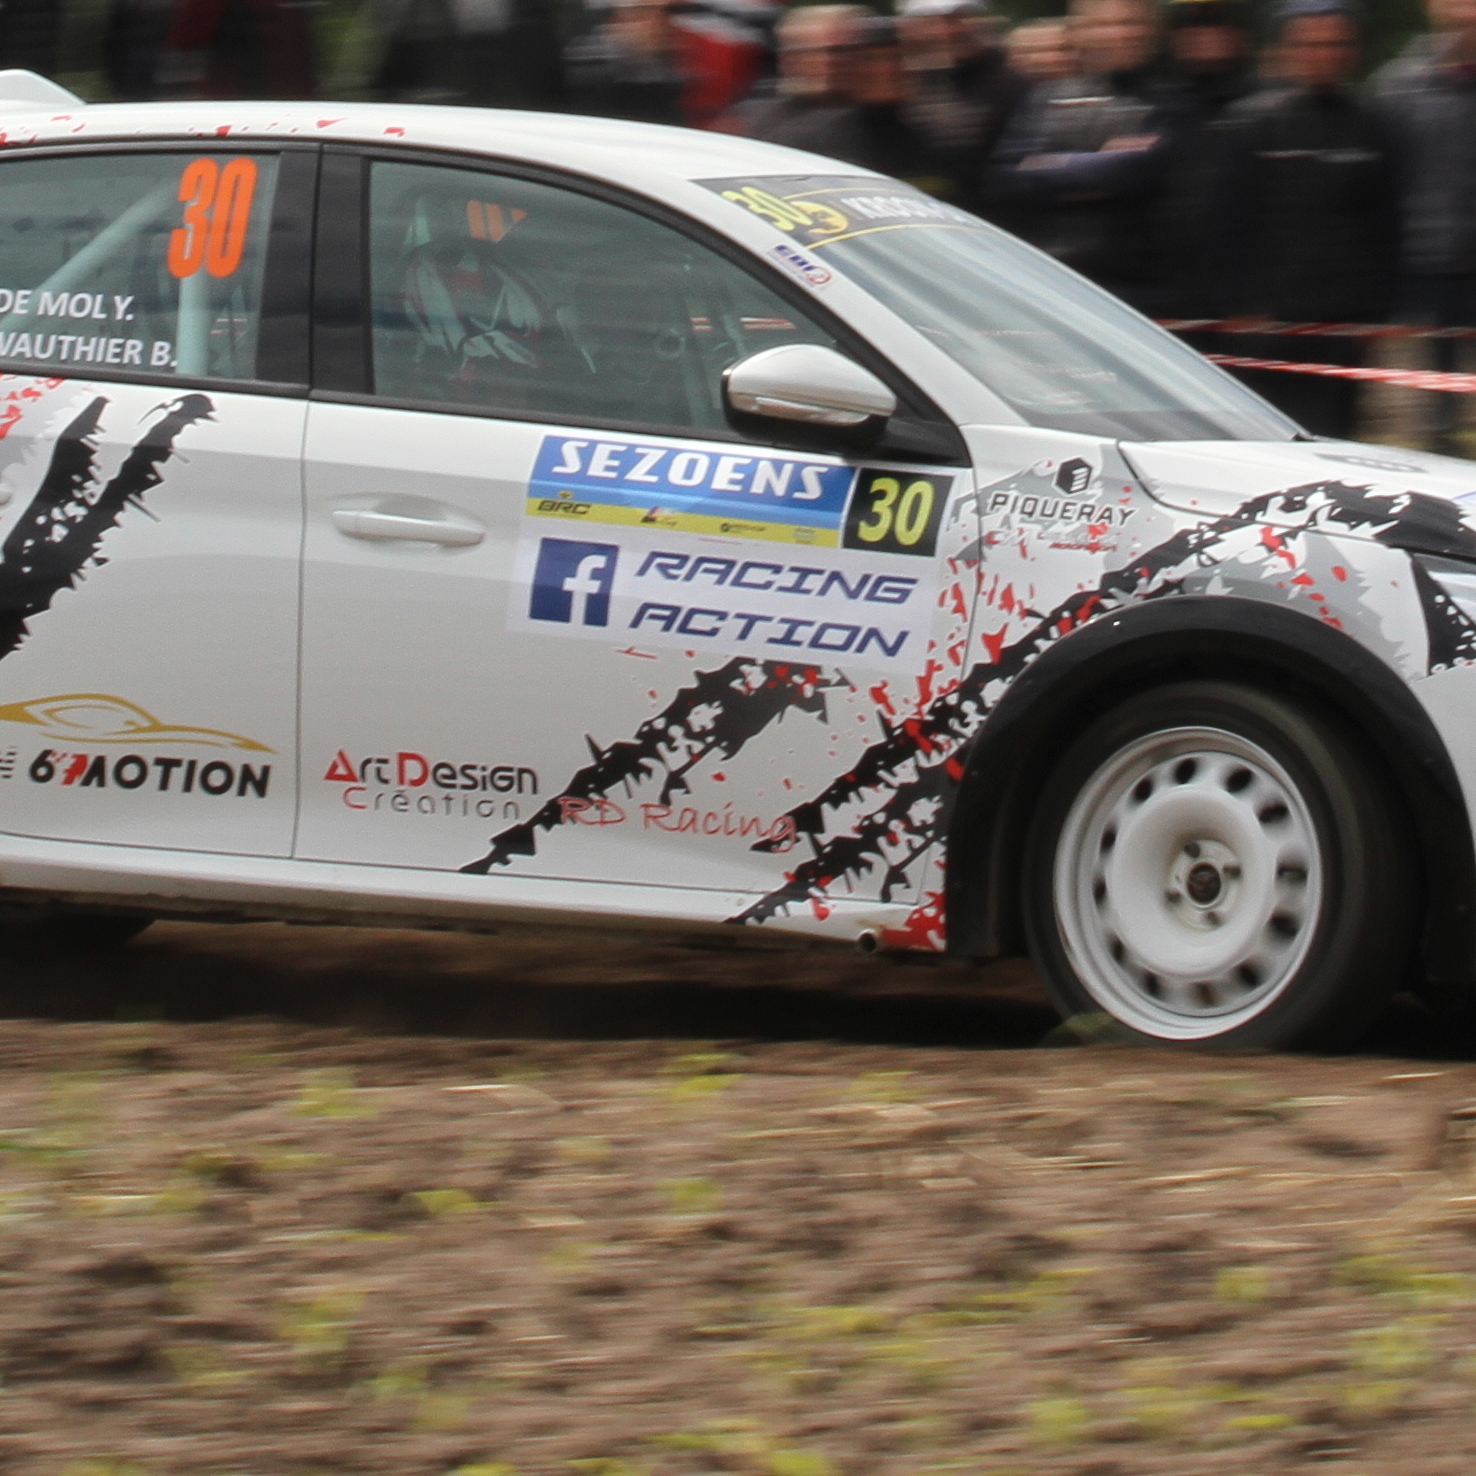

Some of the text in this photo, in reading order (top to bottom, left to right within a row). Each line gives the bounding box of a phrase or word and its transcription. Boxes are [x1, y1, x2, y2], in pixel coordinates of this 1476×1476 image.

[167, 156, 259, 279] 30
[722, 186, 813, 232] 30
[37, 291, 107, 319] MOL
[113, 294, 135, 321] Y.
[151, 340, 179, 368] B.
[552, 440, 829, 501] SEZOENS
[537, 499, 591, 516] BRC
[858, 476, 935, 547] 30
[989, 493, 1136, 526] PIQUERAY
[633, 550, 919, 604] RACING
[628, 602, 911, 658] ACTION
[557, 796, 797, 854] RD Racing
